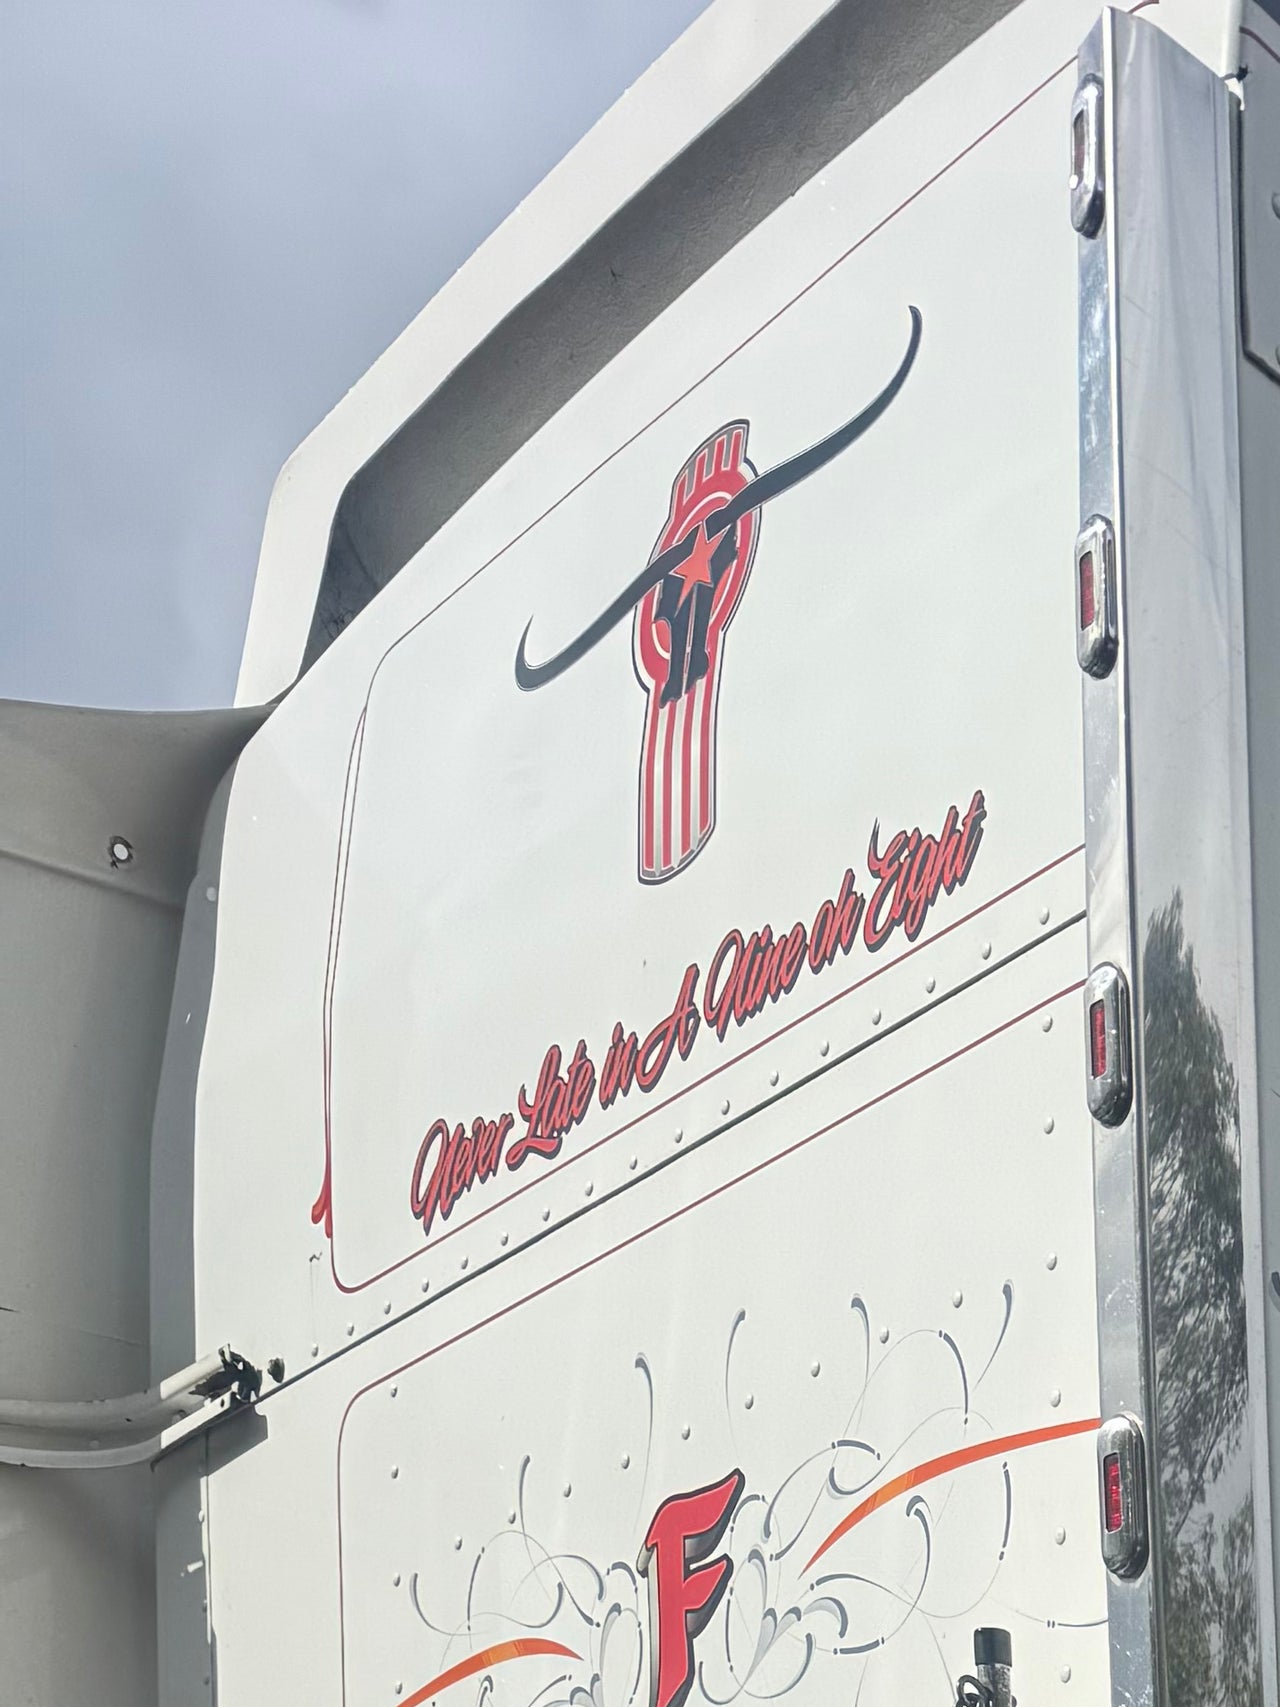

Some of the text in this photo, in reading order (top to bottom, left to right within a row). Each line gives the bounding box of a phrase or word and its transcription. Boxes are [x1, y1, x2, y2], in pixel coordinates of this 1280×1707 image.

[410, 789, 987, 1236] Never Late in A Nine oh Eight
